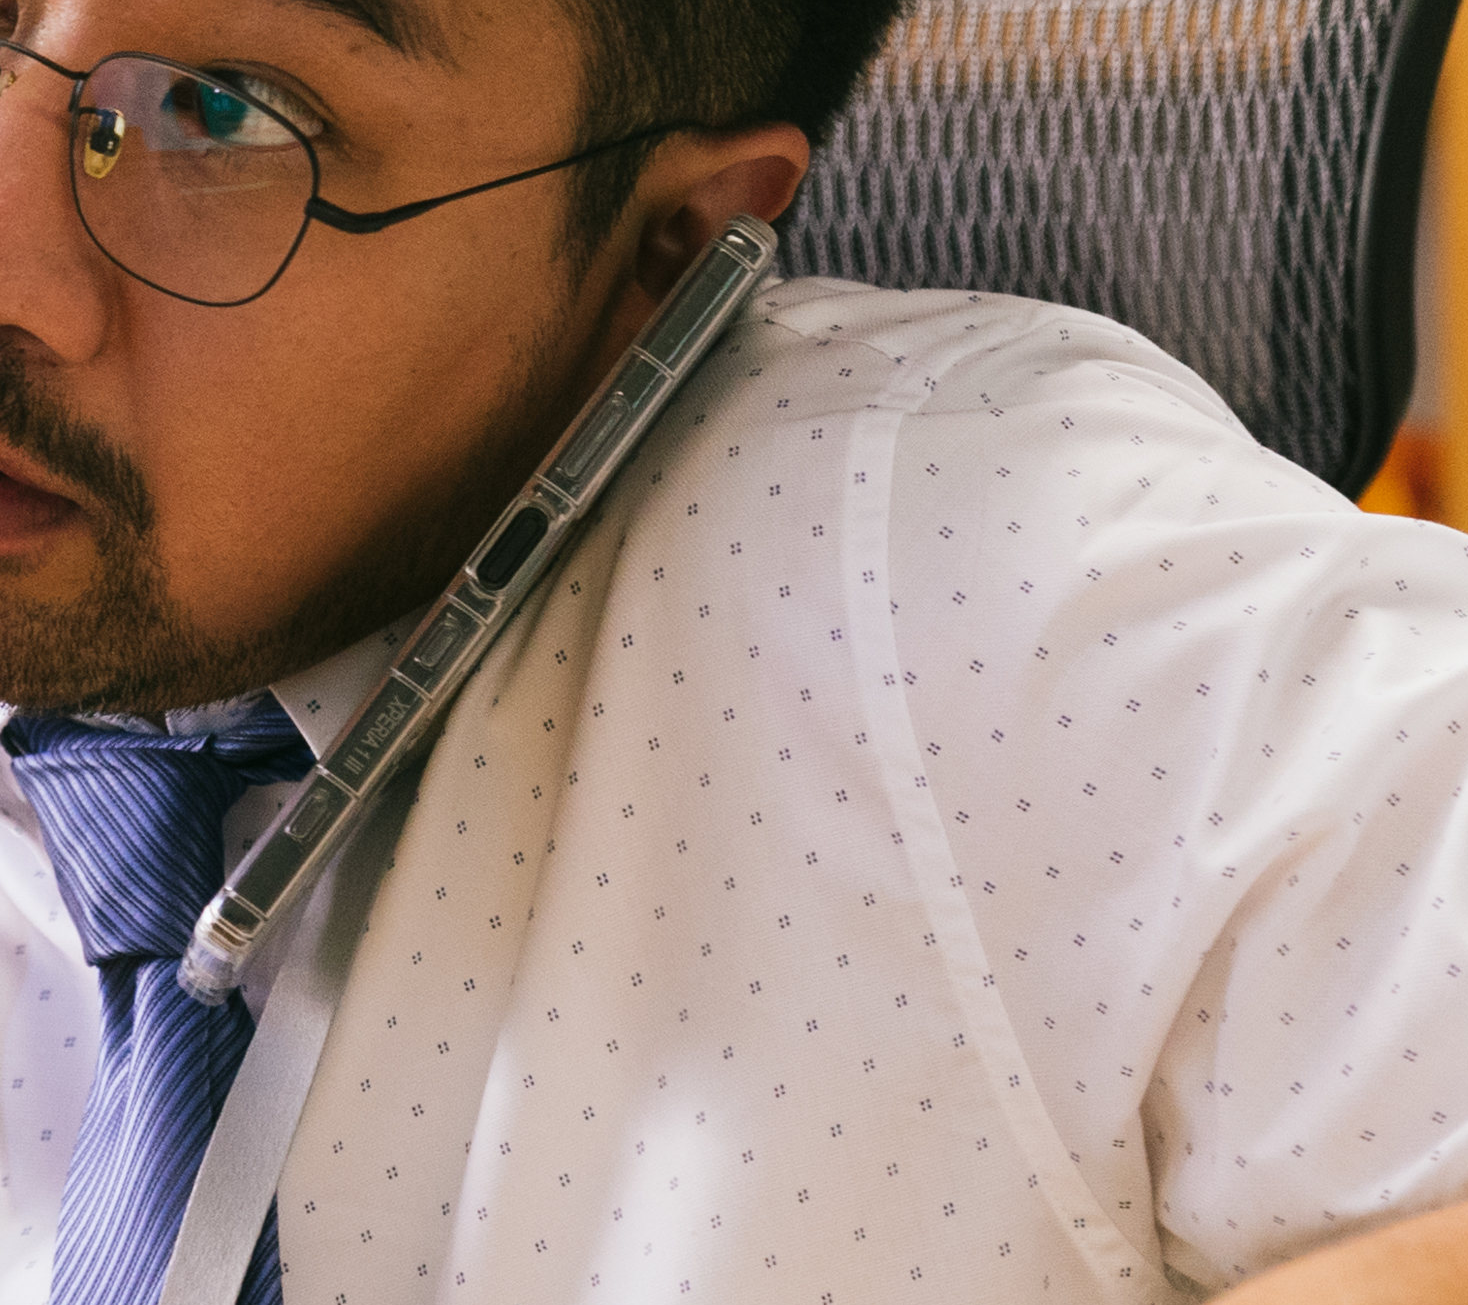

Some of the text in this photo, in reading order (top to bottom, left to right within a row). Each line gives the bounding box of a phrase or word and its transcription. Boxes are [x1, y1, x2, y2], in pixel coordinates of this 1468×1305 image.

[344, 695, 410, 775] XPERIA 1 III
